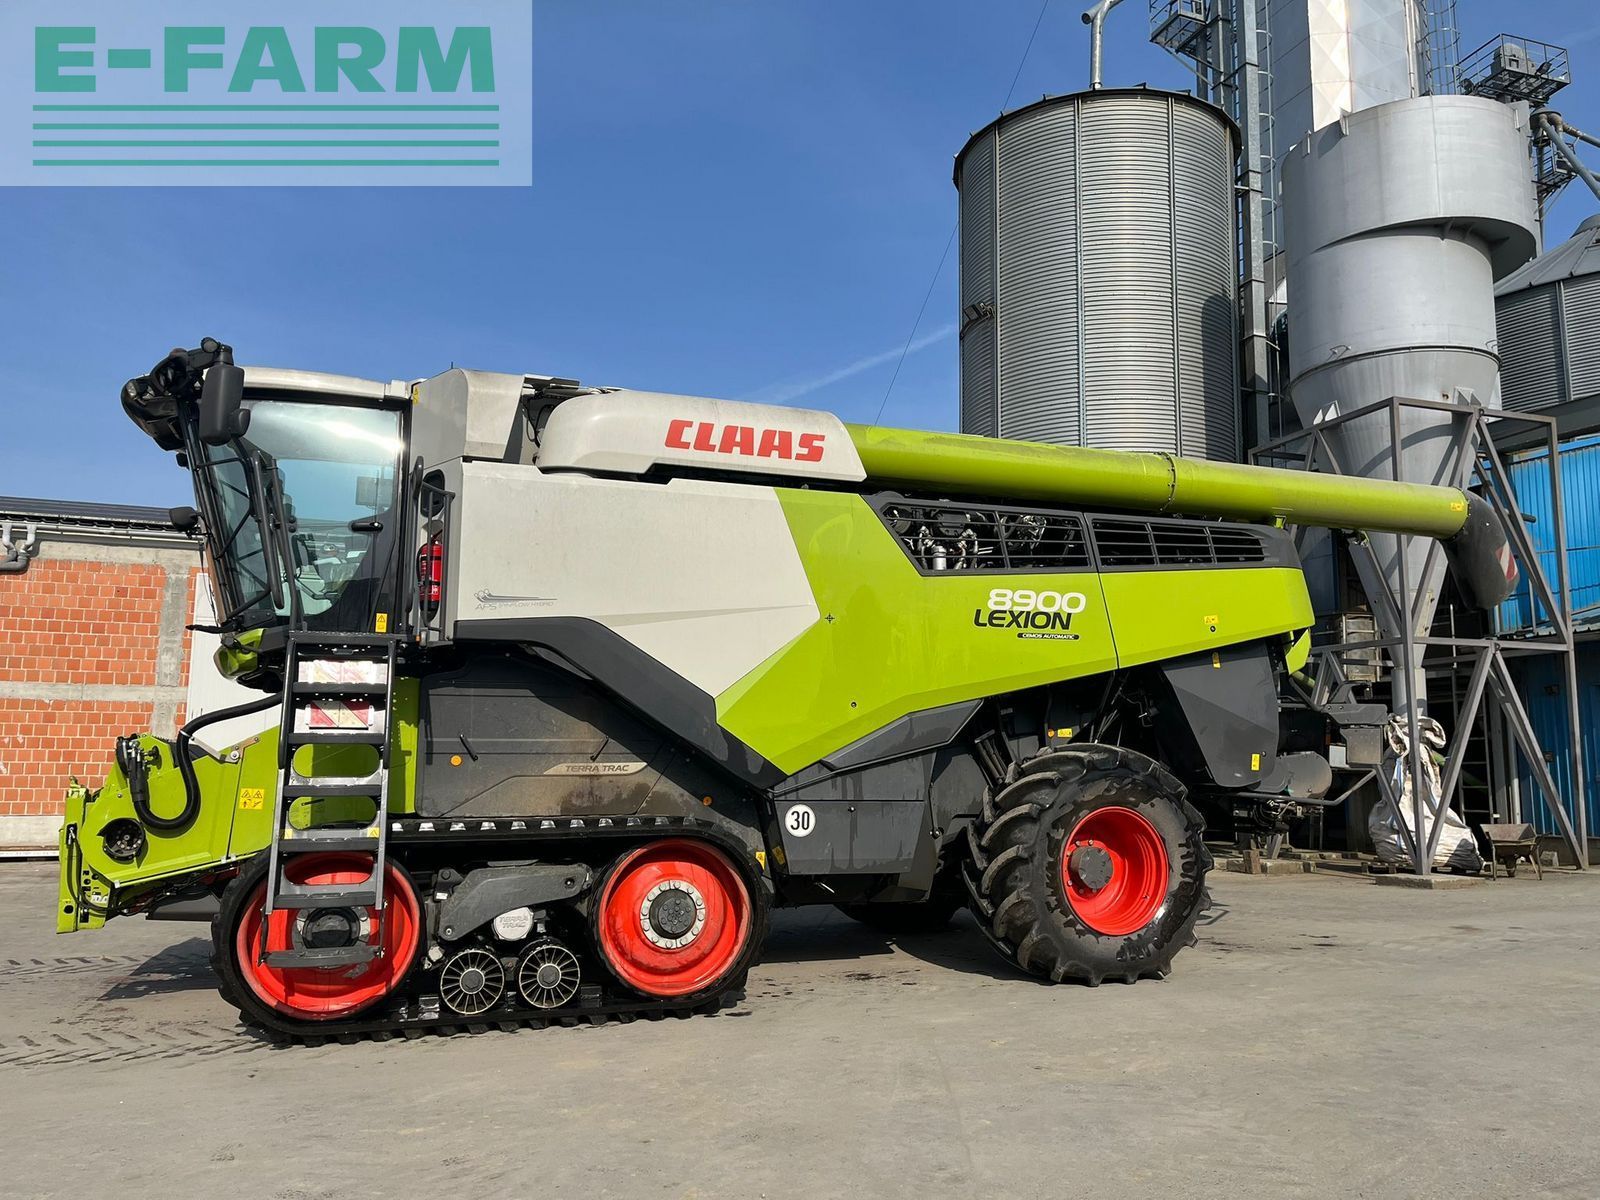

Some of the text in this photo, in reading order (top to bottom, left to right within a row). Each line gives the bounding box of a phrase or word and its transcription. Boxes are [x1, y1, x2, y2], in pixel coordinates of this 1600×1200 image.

[665, 419, 825, 462] CLAAS
[987, 588, 1087, 614] 8900
[974, 609, 1072, 630] LEXION
[602, 764, 629, 772] TRAC
[790, 810, 810, 831] 30
